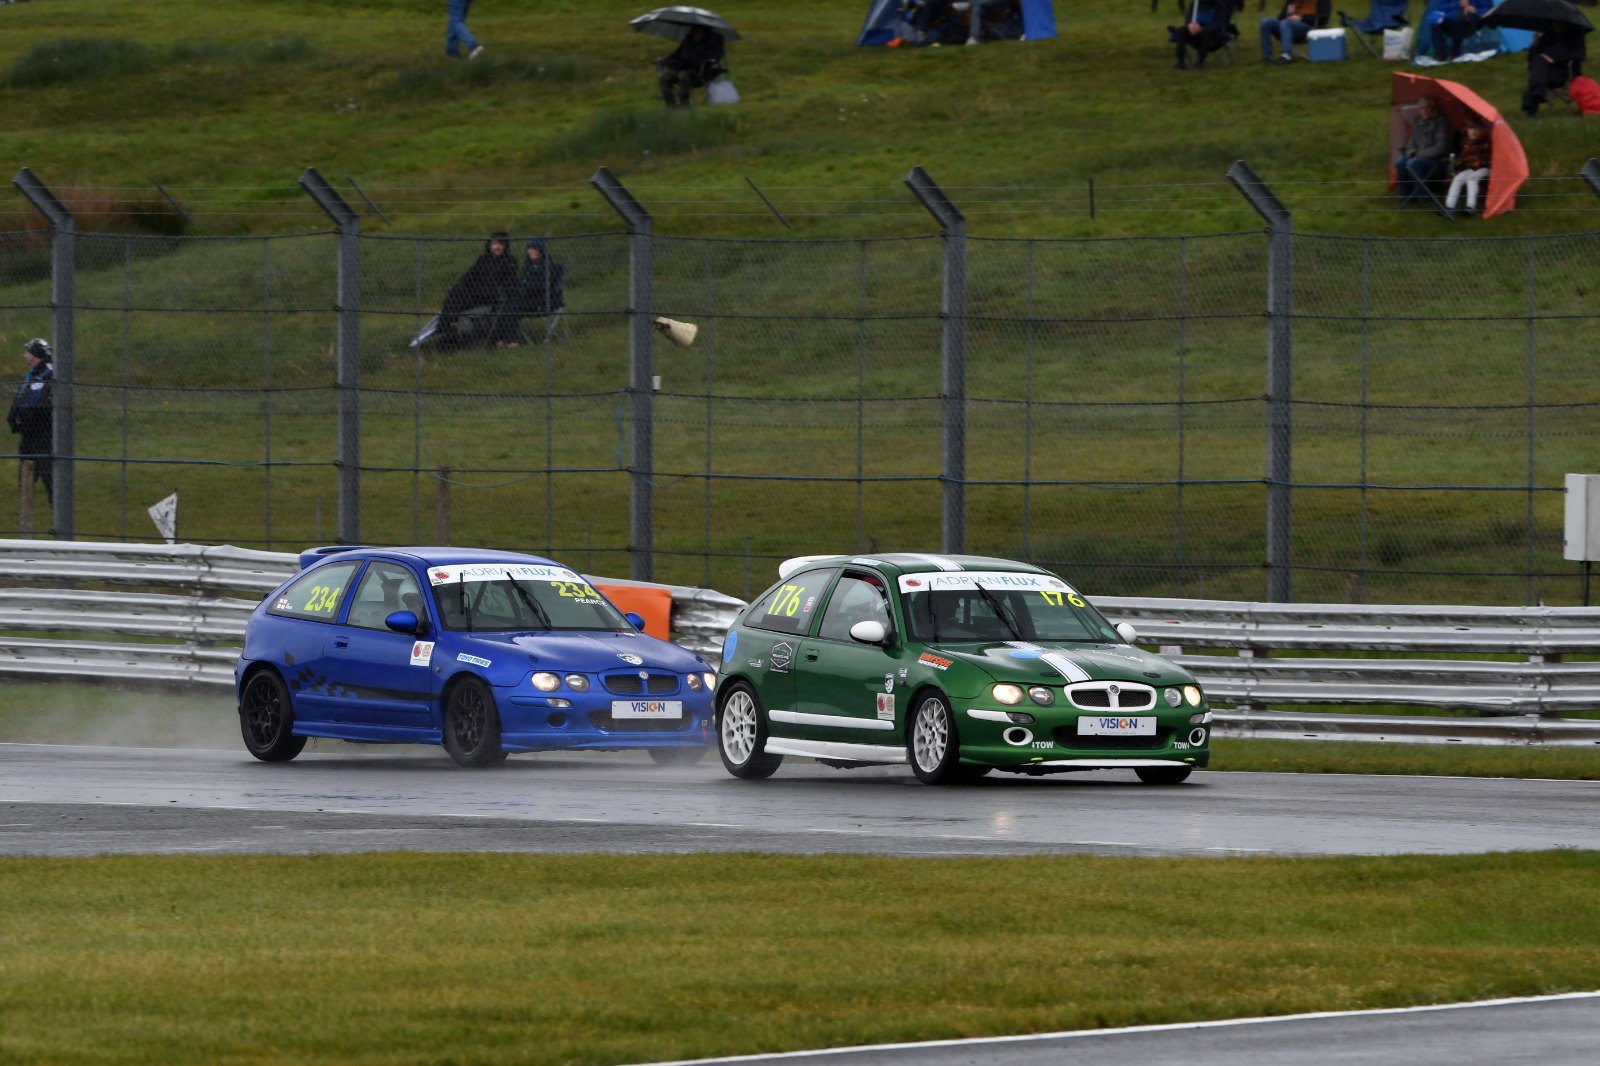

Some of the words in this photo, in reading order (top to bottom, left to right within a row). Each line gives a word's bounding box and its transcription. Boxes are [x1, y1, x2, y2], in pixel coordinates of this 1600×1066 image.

[551, 581, 602, 600] 234
[304, 585, 341, 613] 234
[574, 597, 608, 607] PEARCE
[767, 584, 806, 617] 176
[1040, 591, 1086, 608] 176
[458, 653, 472, 662] TOYO
[631, 701, 666, 713] VISION
[1099, 717, 1138, 729] VISION
[1035, 740, 1054, 749] TOW
[1173, 741, 1188, 750] TOW
